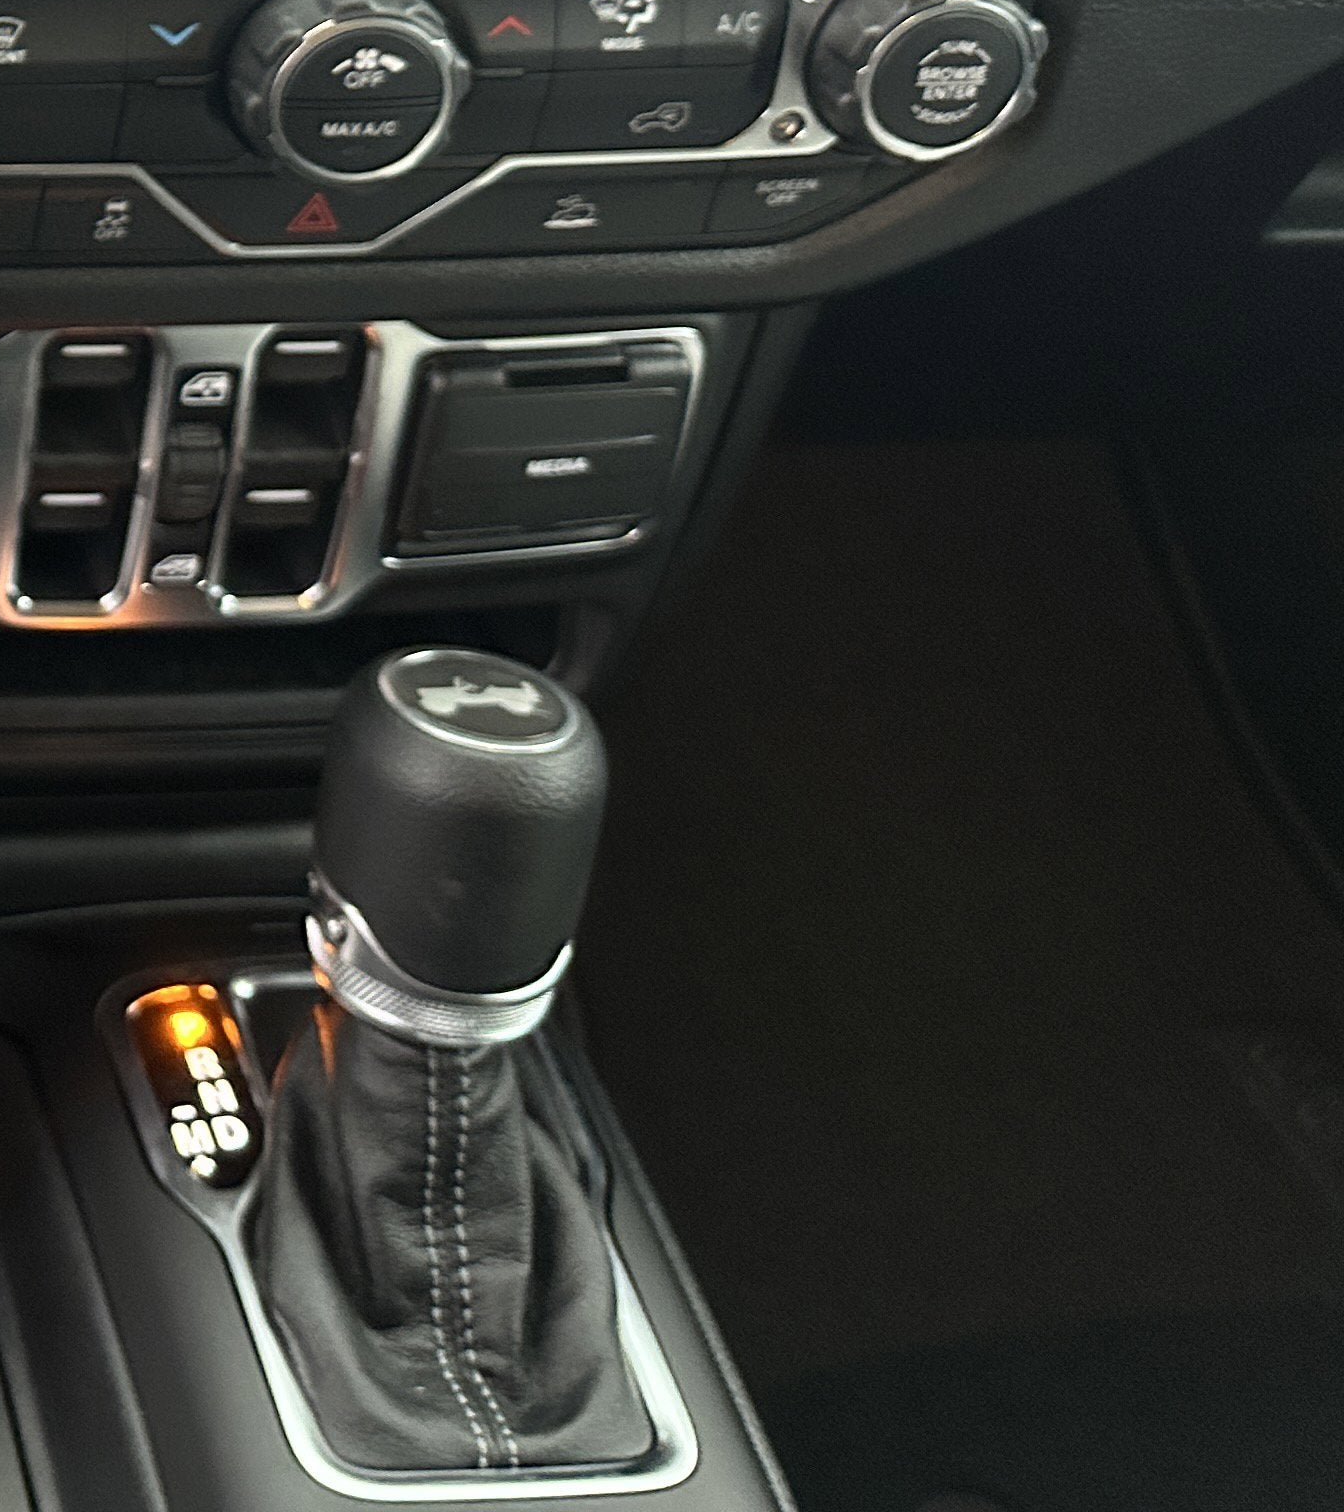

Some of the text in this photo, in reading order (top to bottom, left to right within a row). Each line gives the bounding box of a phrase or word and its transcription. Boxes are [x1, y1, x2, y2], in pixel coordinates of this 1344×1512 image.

[716, 10, 762, 35] A/C
[342, 69, 388, 90] OFF
[183, 1046, 225, 1081] R
[197, 1078, 240, 1115] N
[210, 1115, 250, 1152] D
